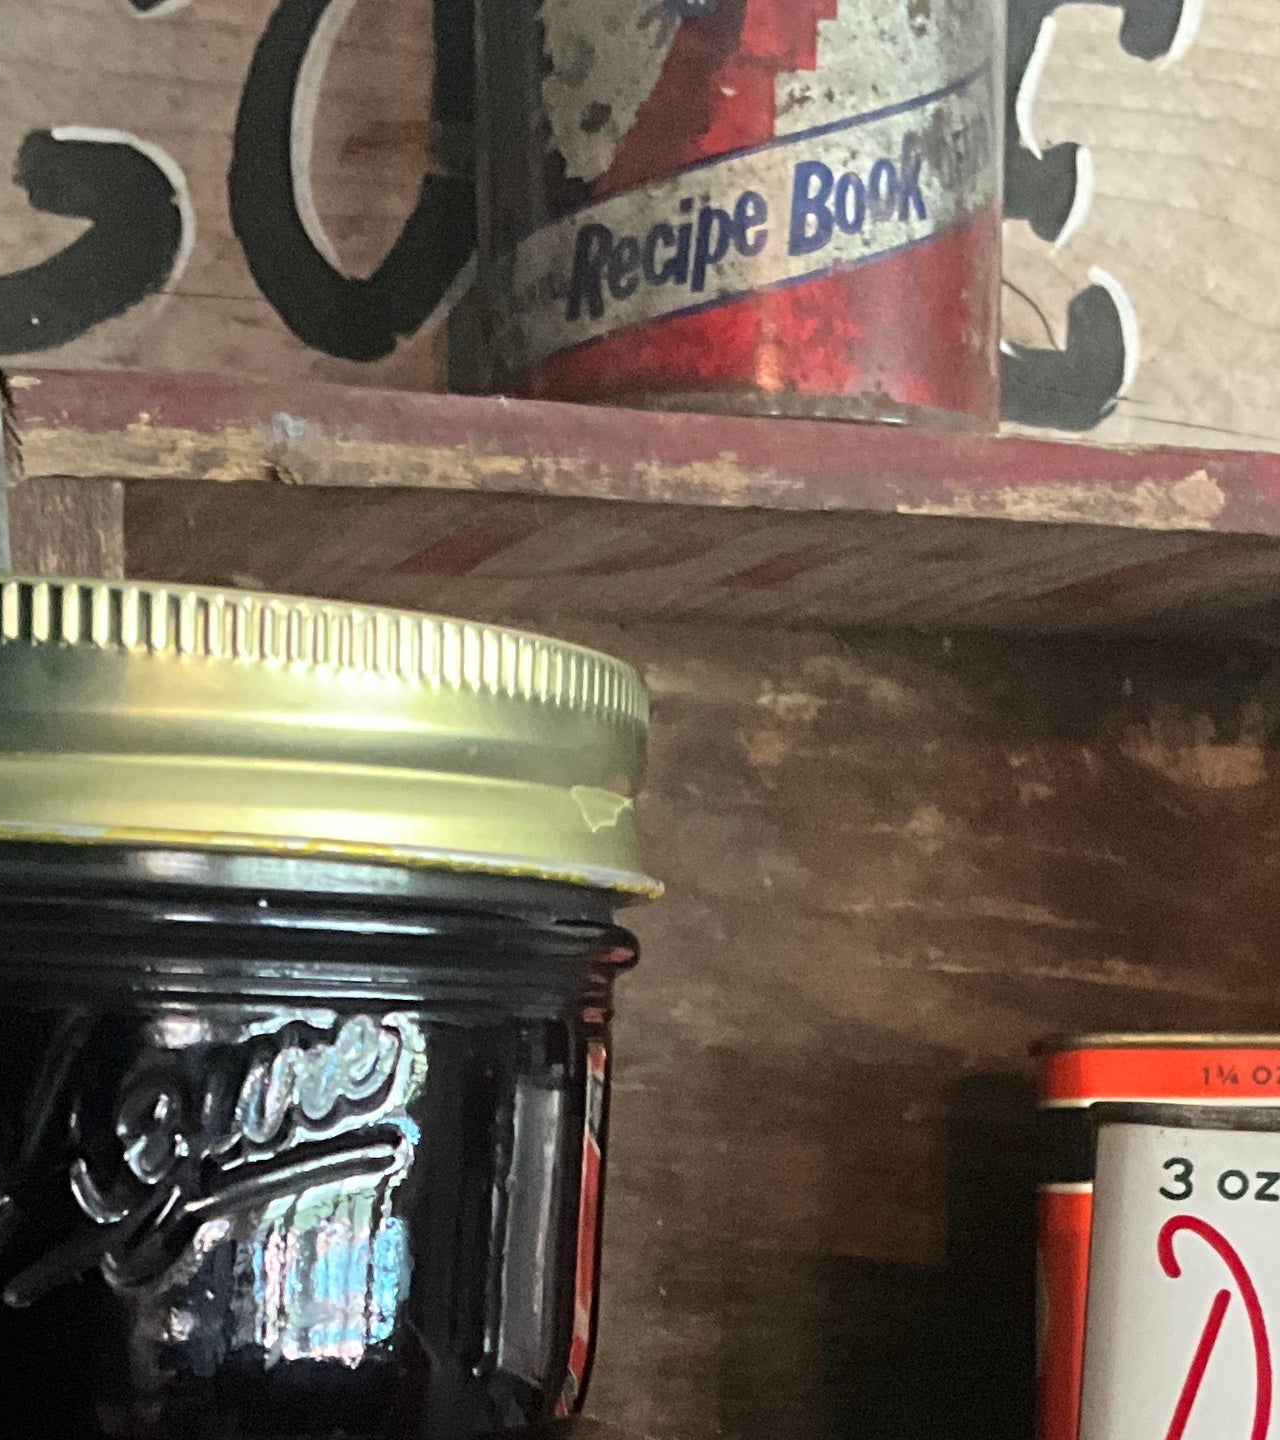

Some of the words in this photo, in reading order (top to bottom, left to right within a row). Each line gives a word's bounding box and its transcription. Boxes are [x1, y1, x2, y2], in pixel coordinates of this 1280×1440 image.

[566, 190, 768, 321] Recipe
[788, 130, 927, 256] Book
[1158, 1157, 1195, 1201] 3
